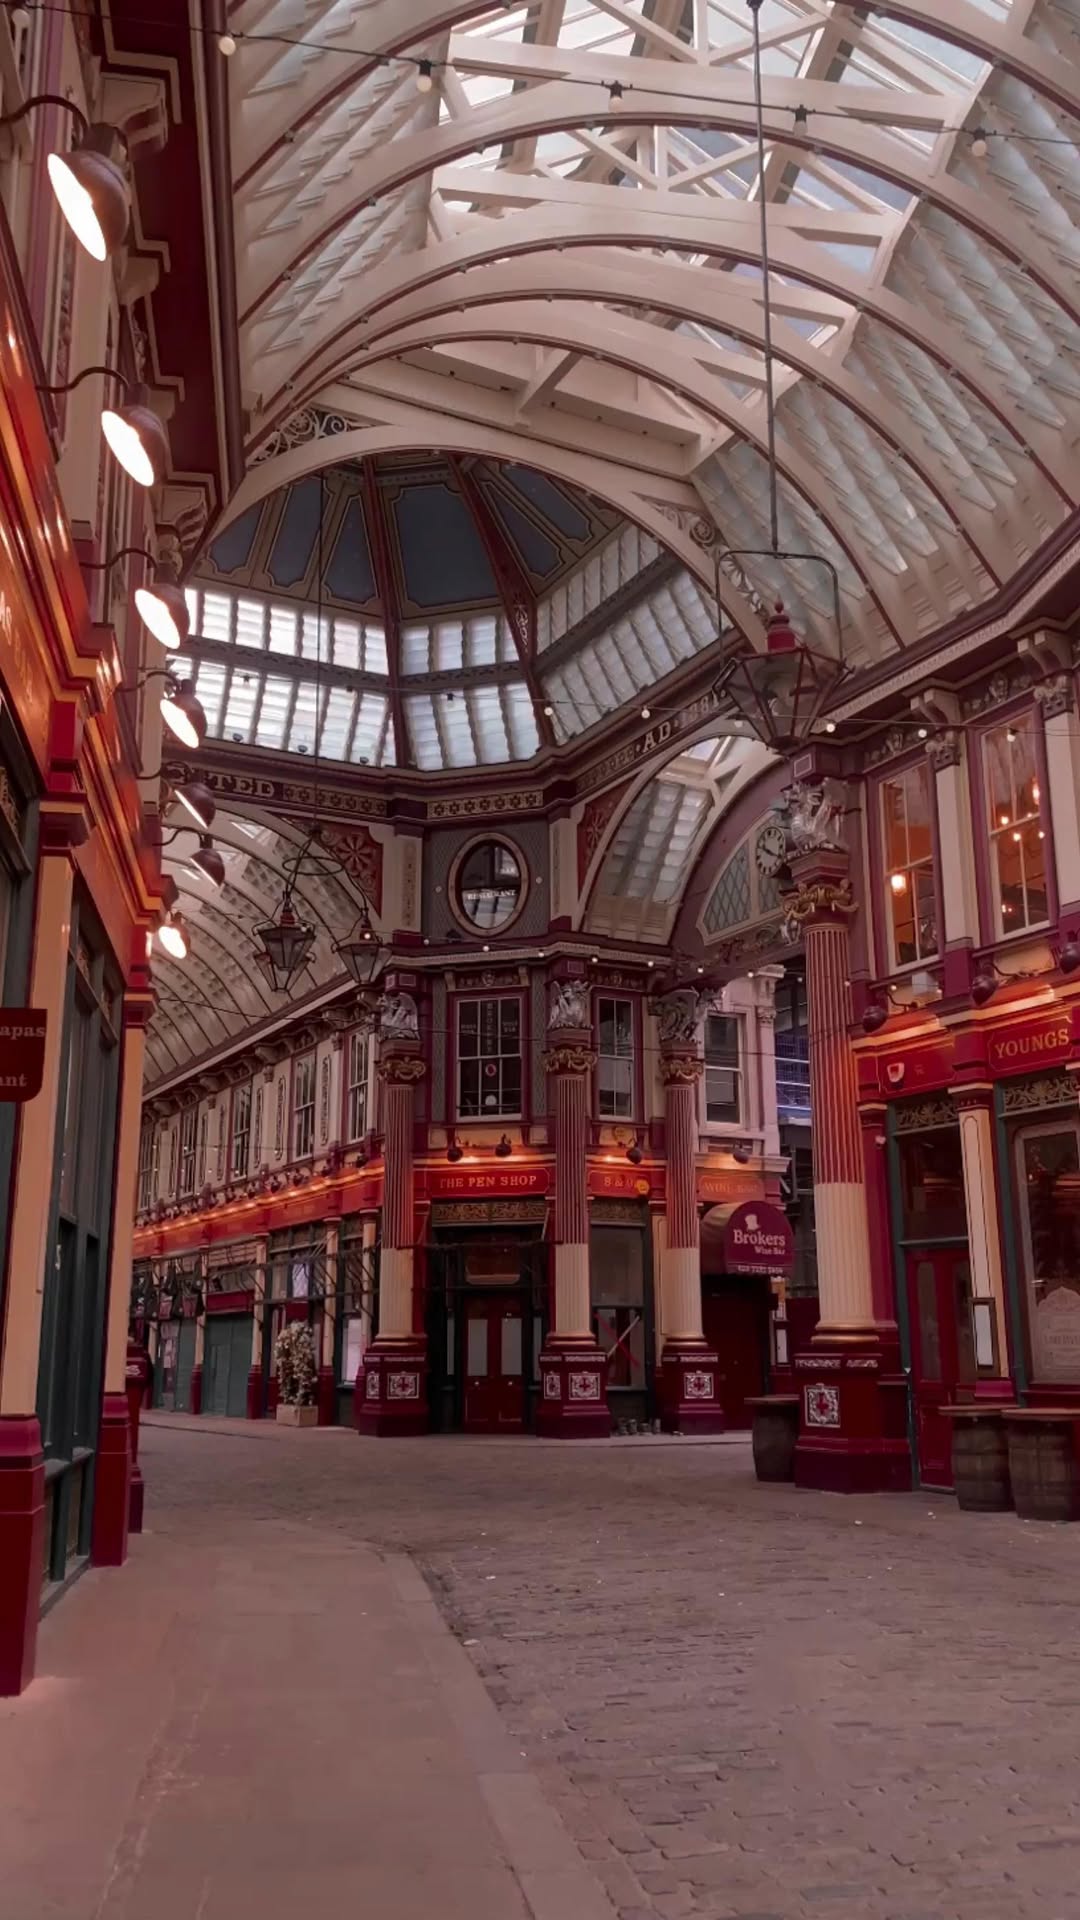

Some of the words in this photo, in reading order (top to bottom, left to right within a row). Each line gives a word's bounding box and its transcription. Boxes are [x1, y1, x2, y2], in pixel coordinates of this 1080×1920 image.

[994, 1028, 1070, 1059] YOUNGS
[440, 1177, 464, 1189] THE
[468, 1176, 495, 1187] PEN
[500, 1175, 537, 1186] SHOP
[732, 1229, 786, 1246] Brokers
